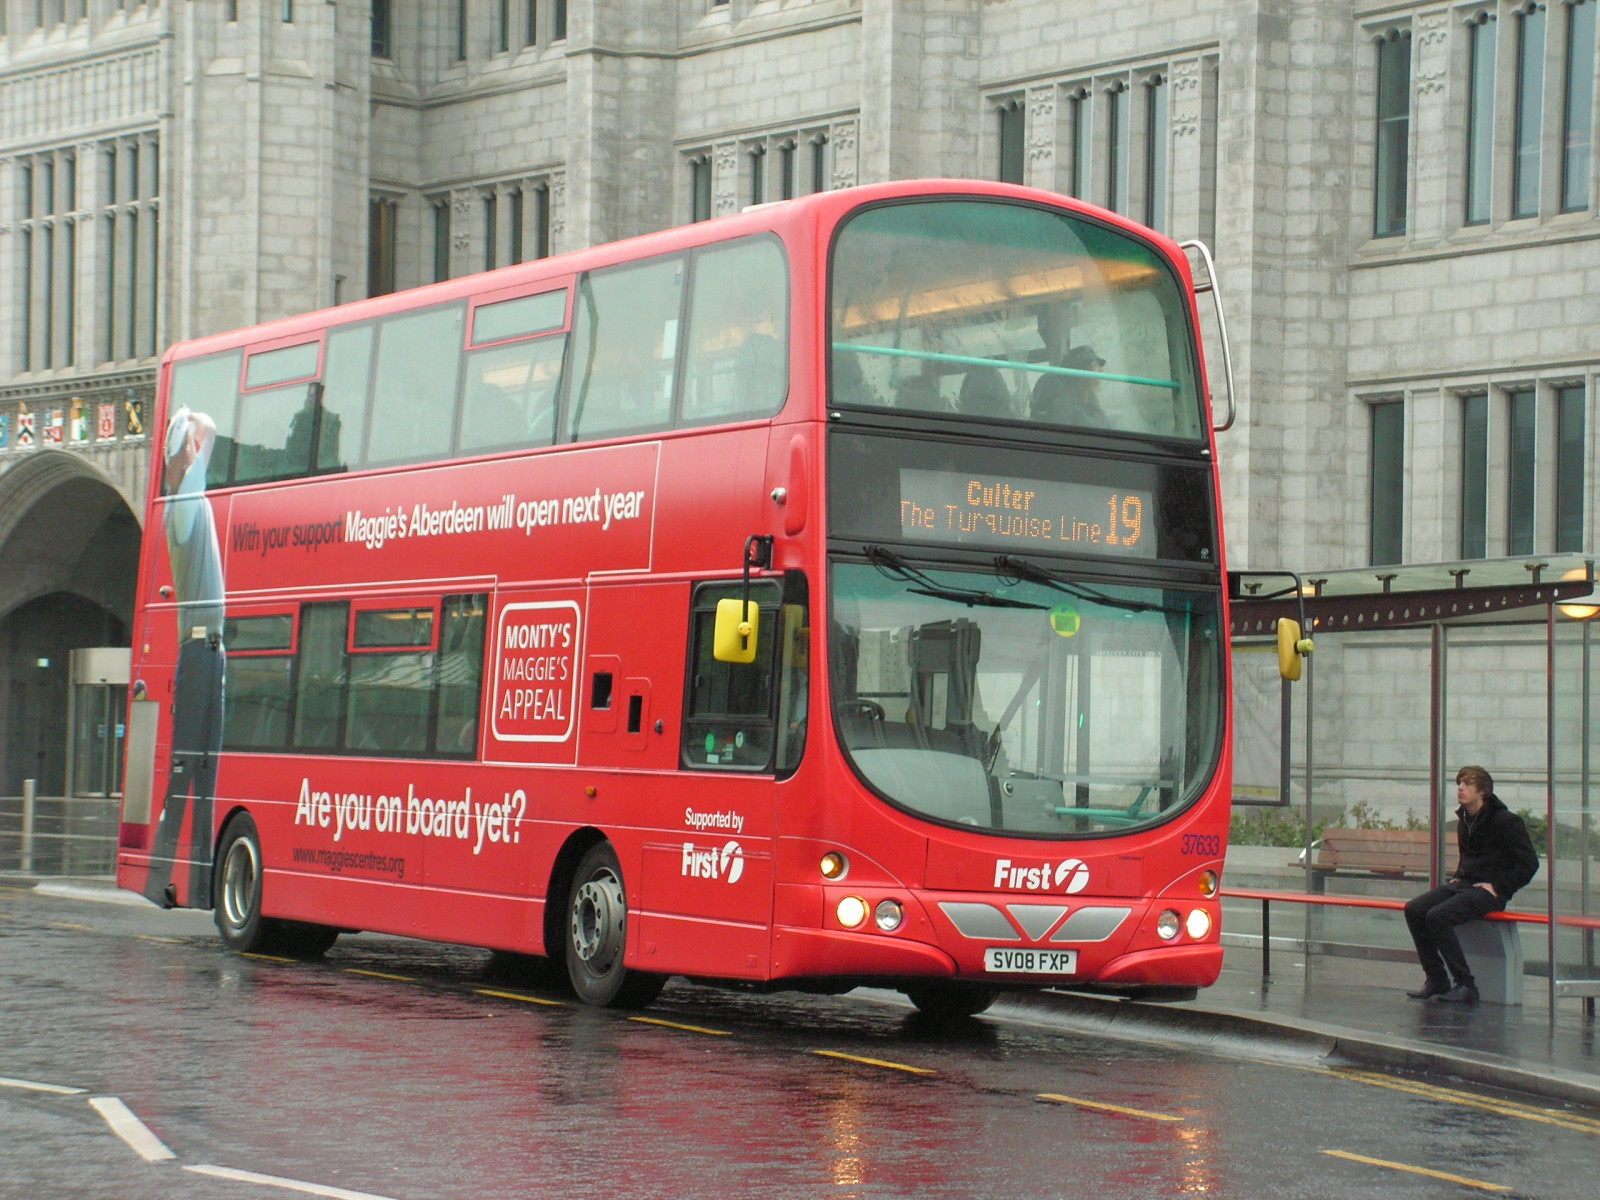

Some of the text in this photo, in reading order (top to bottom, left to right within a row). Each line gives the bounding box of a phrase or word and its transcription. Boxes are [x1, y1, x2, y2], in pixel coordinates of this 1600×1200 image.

[966, 480, 1035, 511] Culter
[232, 487, 645, 557] With your support Maggie's Aberdeen will open next year
[899, 500, 1101, 543] The Turquoise Line
[1105, 494, 1142, 546] 19
[505, 623, 571, 649] MONTY'S
[503, 656, 568, 681] MAGGIE'S
[499, 689, 566, 720] APPEAL
[294, 777, 526, 855] Are you on board yet?
[684, 807, 744, 834] Supported by
[1181, 833, 1220, 856] 37633
[292, 846, 405, 879] www.maggiescentres.org
[681, 842, 719, 879] First
[993, 859, 1052, 890] First
[994, 952, 1070, 971] SV08 FXP
